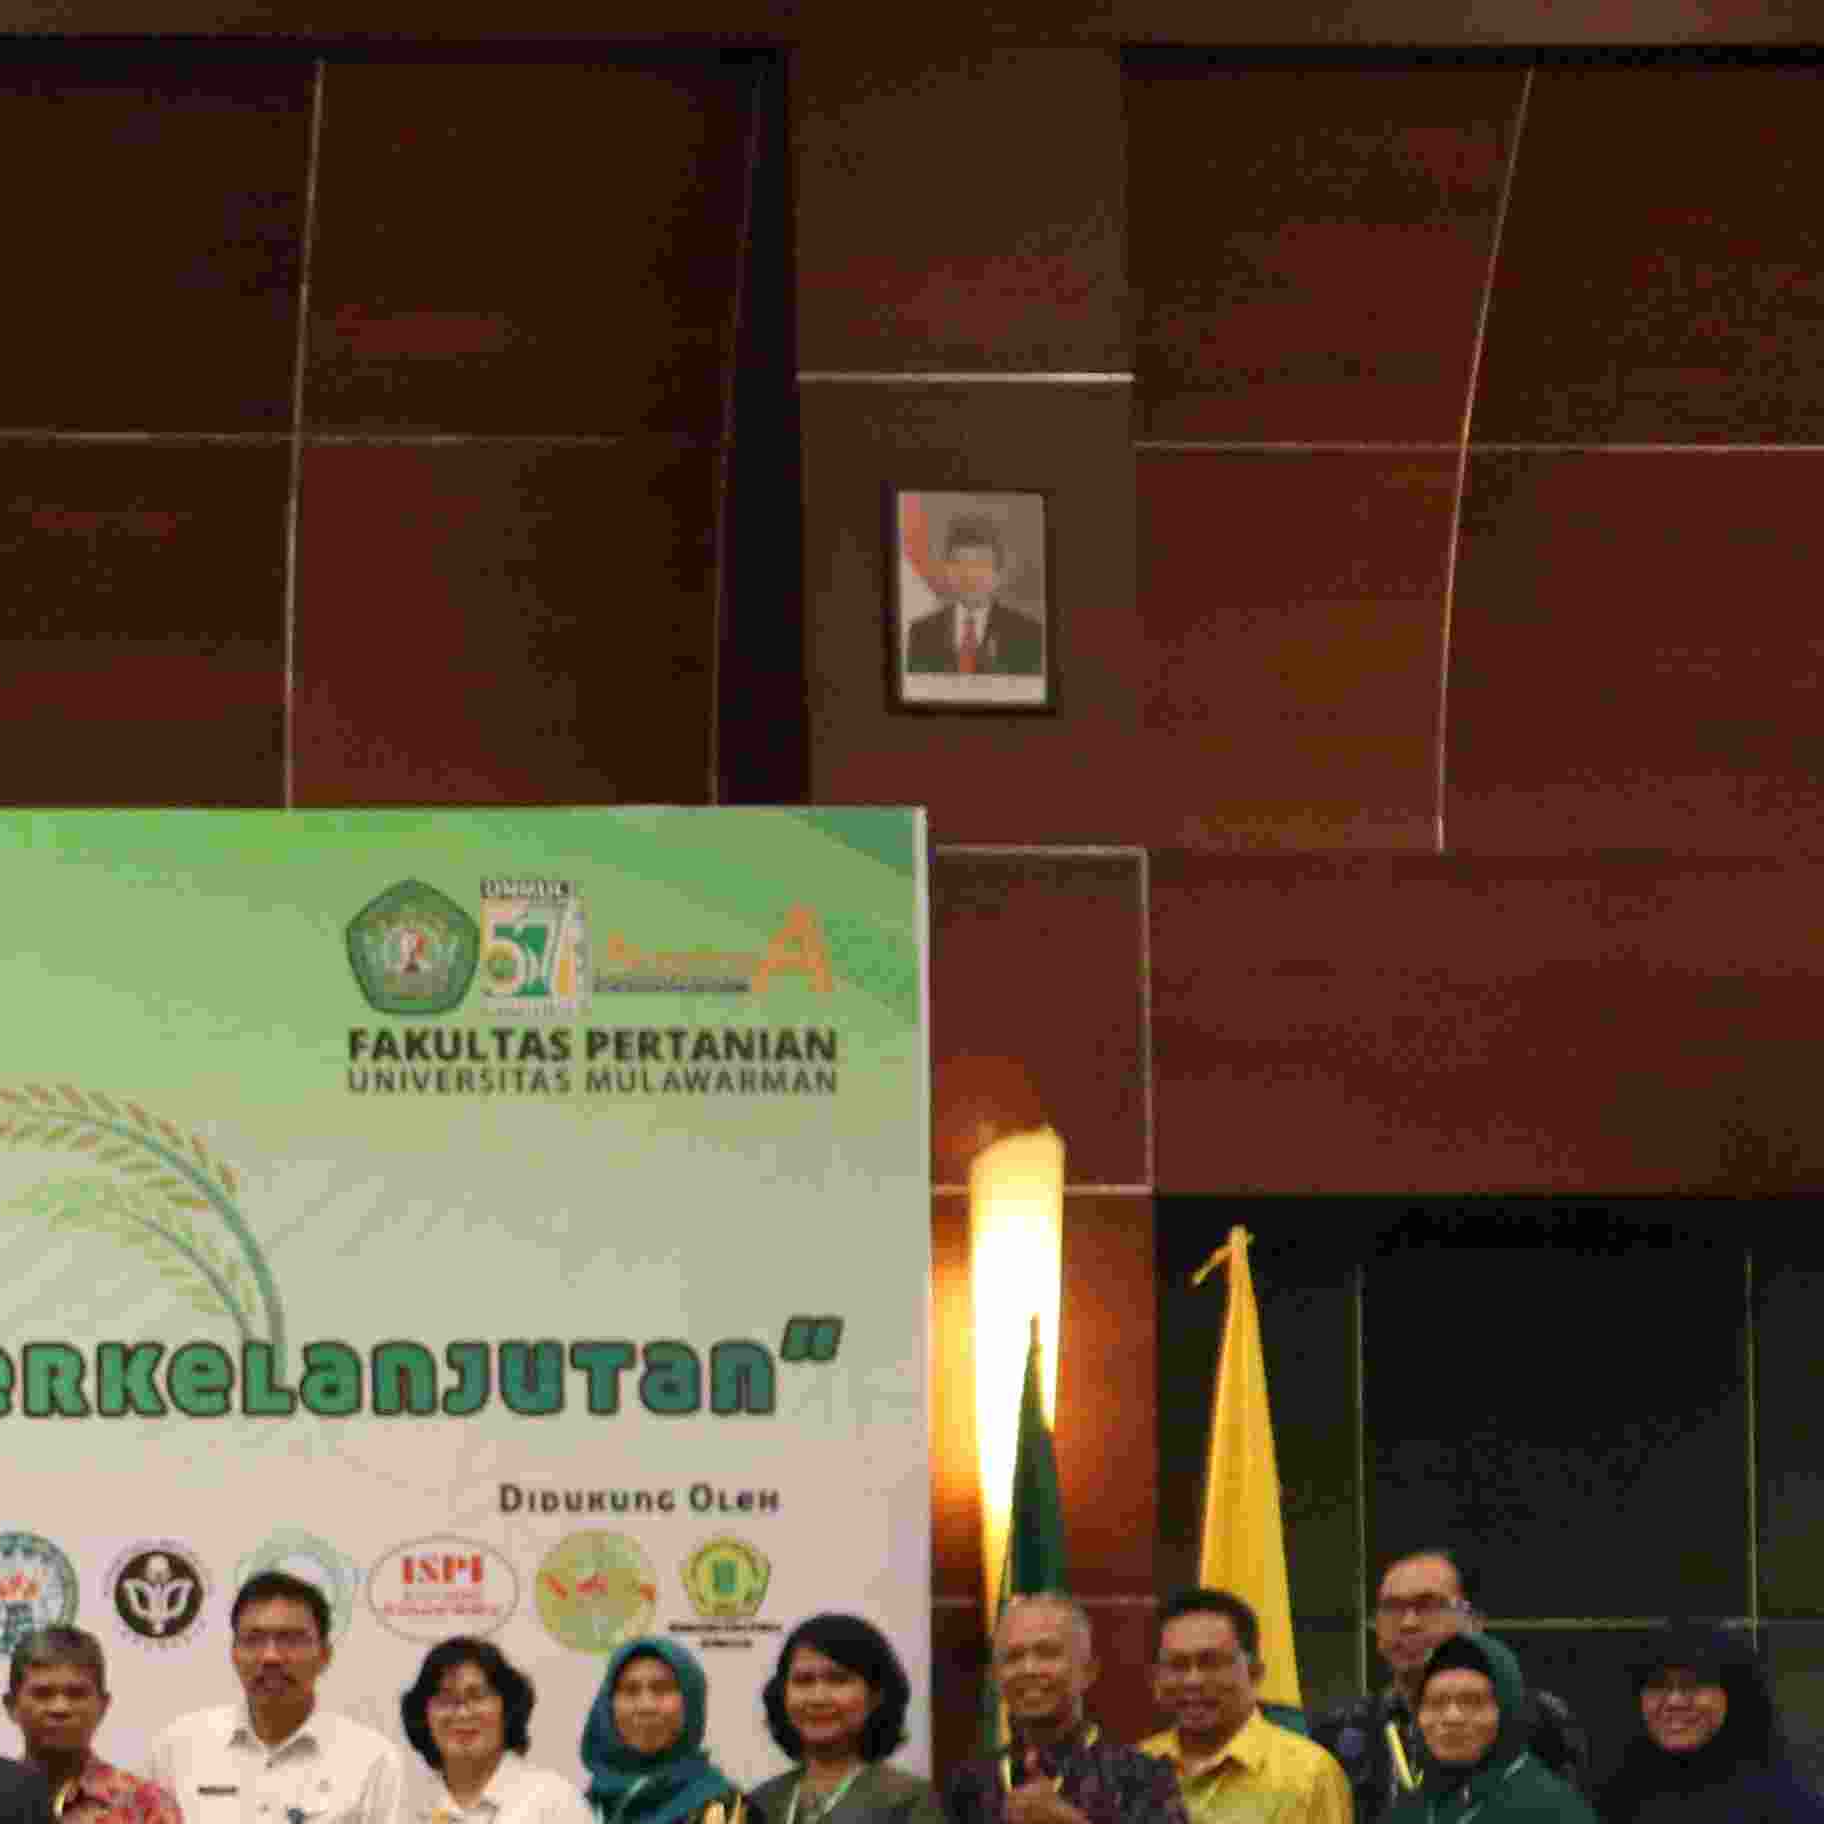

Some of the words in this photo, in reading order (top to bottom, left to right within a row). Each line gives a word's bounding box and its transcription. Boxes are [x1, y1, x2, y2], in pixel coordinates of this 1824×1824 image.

[348, 1027, 572, 1062] FAKULTAS
[585, 1027, 837, 1062] PERTANIAN
[348, 1067, 571, 1095] UNIVERSITAS
[585, 1067, 837, 1095] MULAWARMAN
[401, 1554, 485, 1586] ISPI
